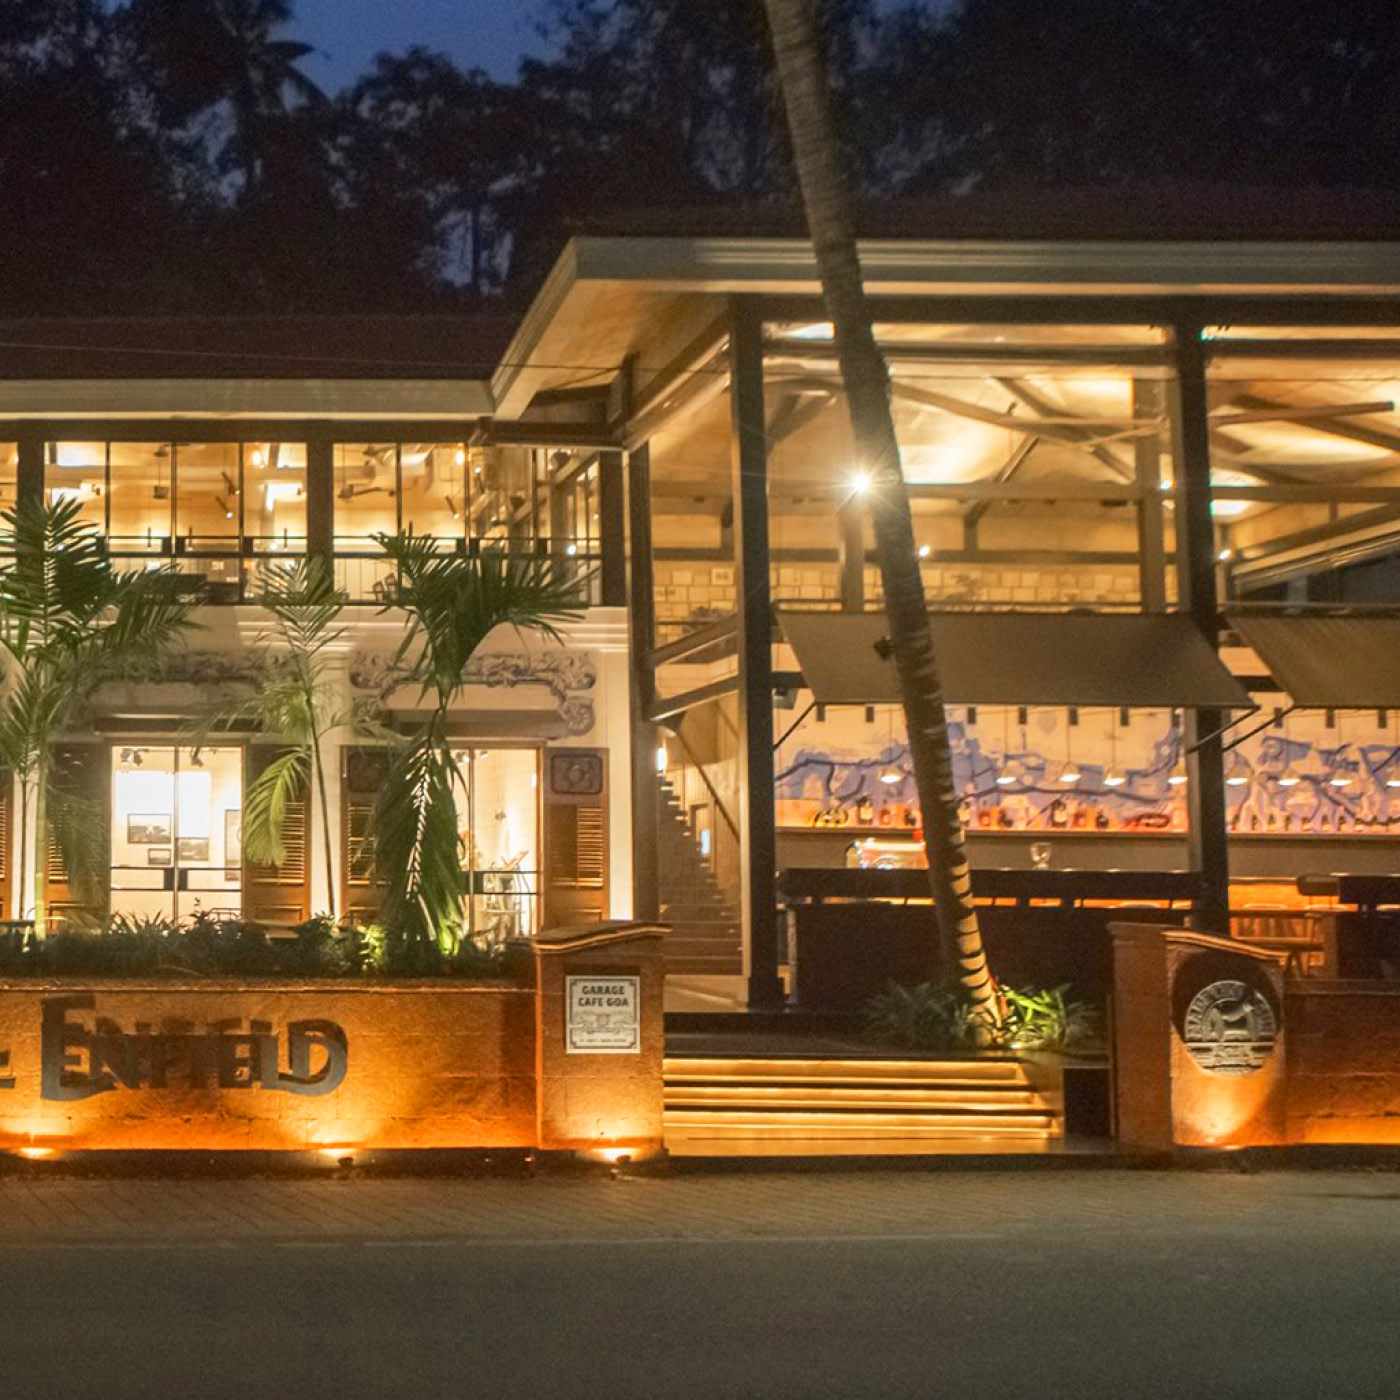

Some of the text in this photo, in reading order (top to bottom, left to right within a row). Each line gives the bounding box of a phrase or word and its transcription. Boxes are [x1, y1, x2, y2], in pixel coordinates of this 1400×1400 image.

[582, 985, 625, 995] GARAGE
[578, 997, 629, 1007] CAFE GOA
[40, 1014, 348, 1101] ENFIELD
